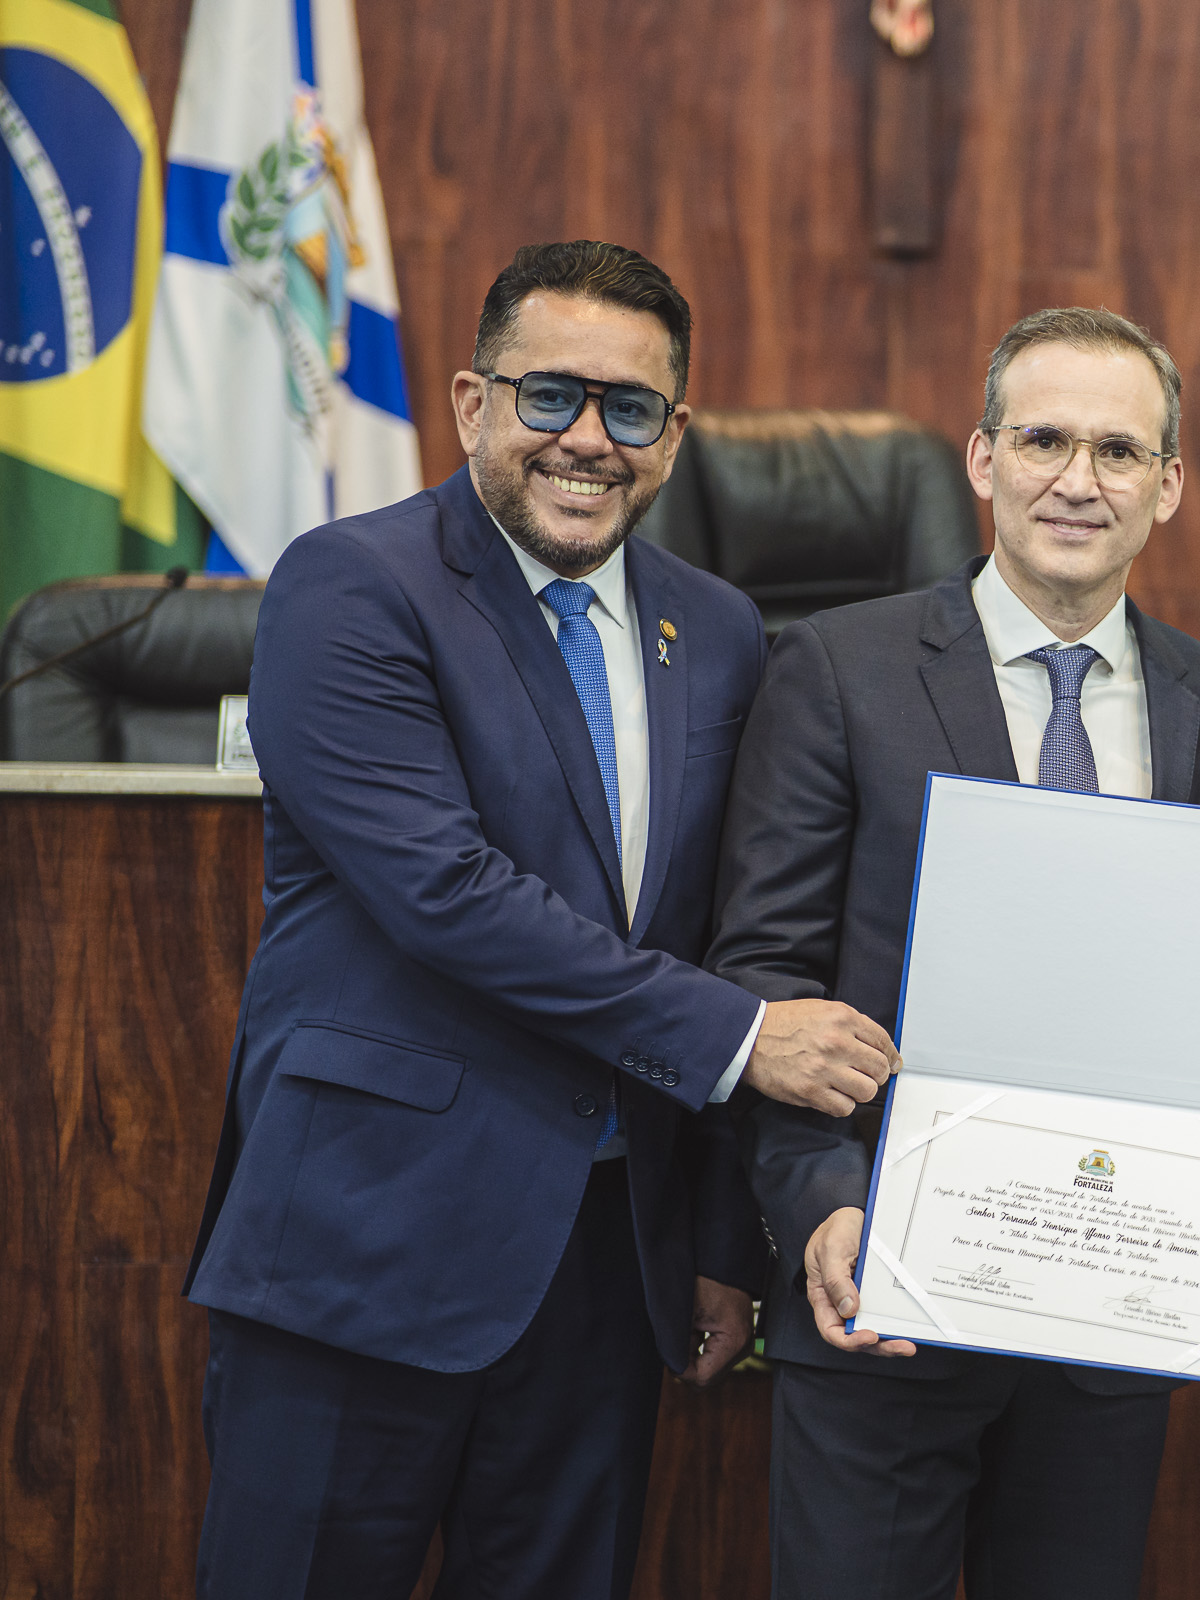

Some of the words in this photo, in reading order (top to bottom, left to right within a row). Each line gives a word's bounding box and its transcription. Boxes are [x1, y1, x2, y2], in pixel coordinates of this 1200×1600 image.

[1044, 1187, 1077, 1200] Municipal
[1131, 1204, 1152, 1212] acordo
[1073, 1178, 1113, 1193] FORTALEZA
[933, 1187, 955, 1197] Projeto
[969, 1193, 993, 1203] Decreto
[996, 1200, 1028, 1210] Legislativo
[1086, 1217, 1109, 1225] autoria
[1122, 1222, 1150, 1232] Vereador
[985, 1186, 1008, 1196] Decreto
[1011, 1192, 1043, 1202] Legislativo
[1099, 1206, 1127, 1218] dezembro
[1159, 1219, 1182, 1227] oriundo
[966, 1206, 995, 1219] Senhor
[1000, 1211, 1038, 1227] Fernando
[1041, 1219, 1078, 1237] Henrique
[1081, 1227, 1111, 1241] Affonso
[1116, 1233, 1149, 1247] Ferreira
[1166, 1242, 1200, 1257] Amorim,
[1017, 1248, 1055, 1263] Municipal
[1150, 1274, 1168, 1282] maio
